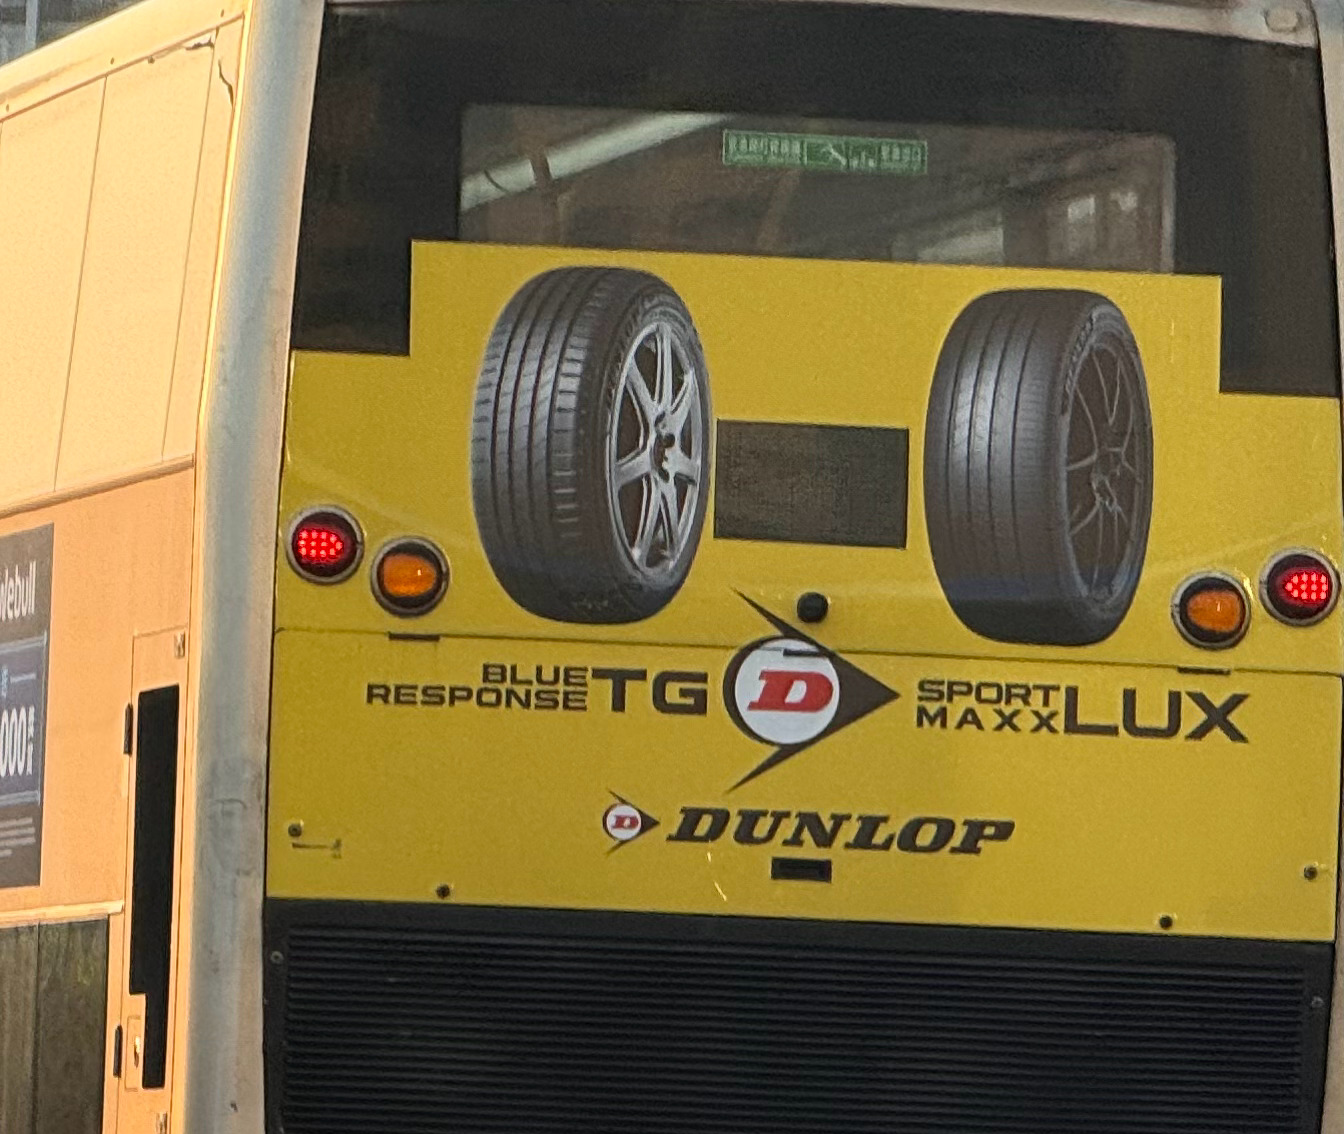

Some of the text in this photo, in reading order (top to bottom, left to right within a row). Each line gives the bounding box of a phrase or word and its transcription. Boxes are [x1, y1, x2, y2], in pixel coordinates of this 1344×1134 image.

[483, 662, 588, 685] BLUE
[366, 682, 587, 711] RESPONSE
[592, 667, 709, 716] TG
[917, 679, 1061, 708] SPORT
[916, 707, 1059, 734] MAXX
[1063, 686, 1250, 744] LUX
[666, 806, 1016, 856] DUNLOP
